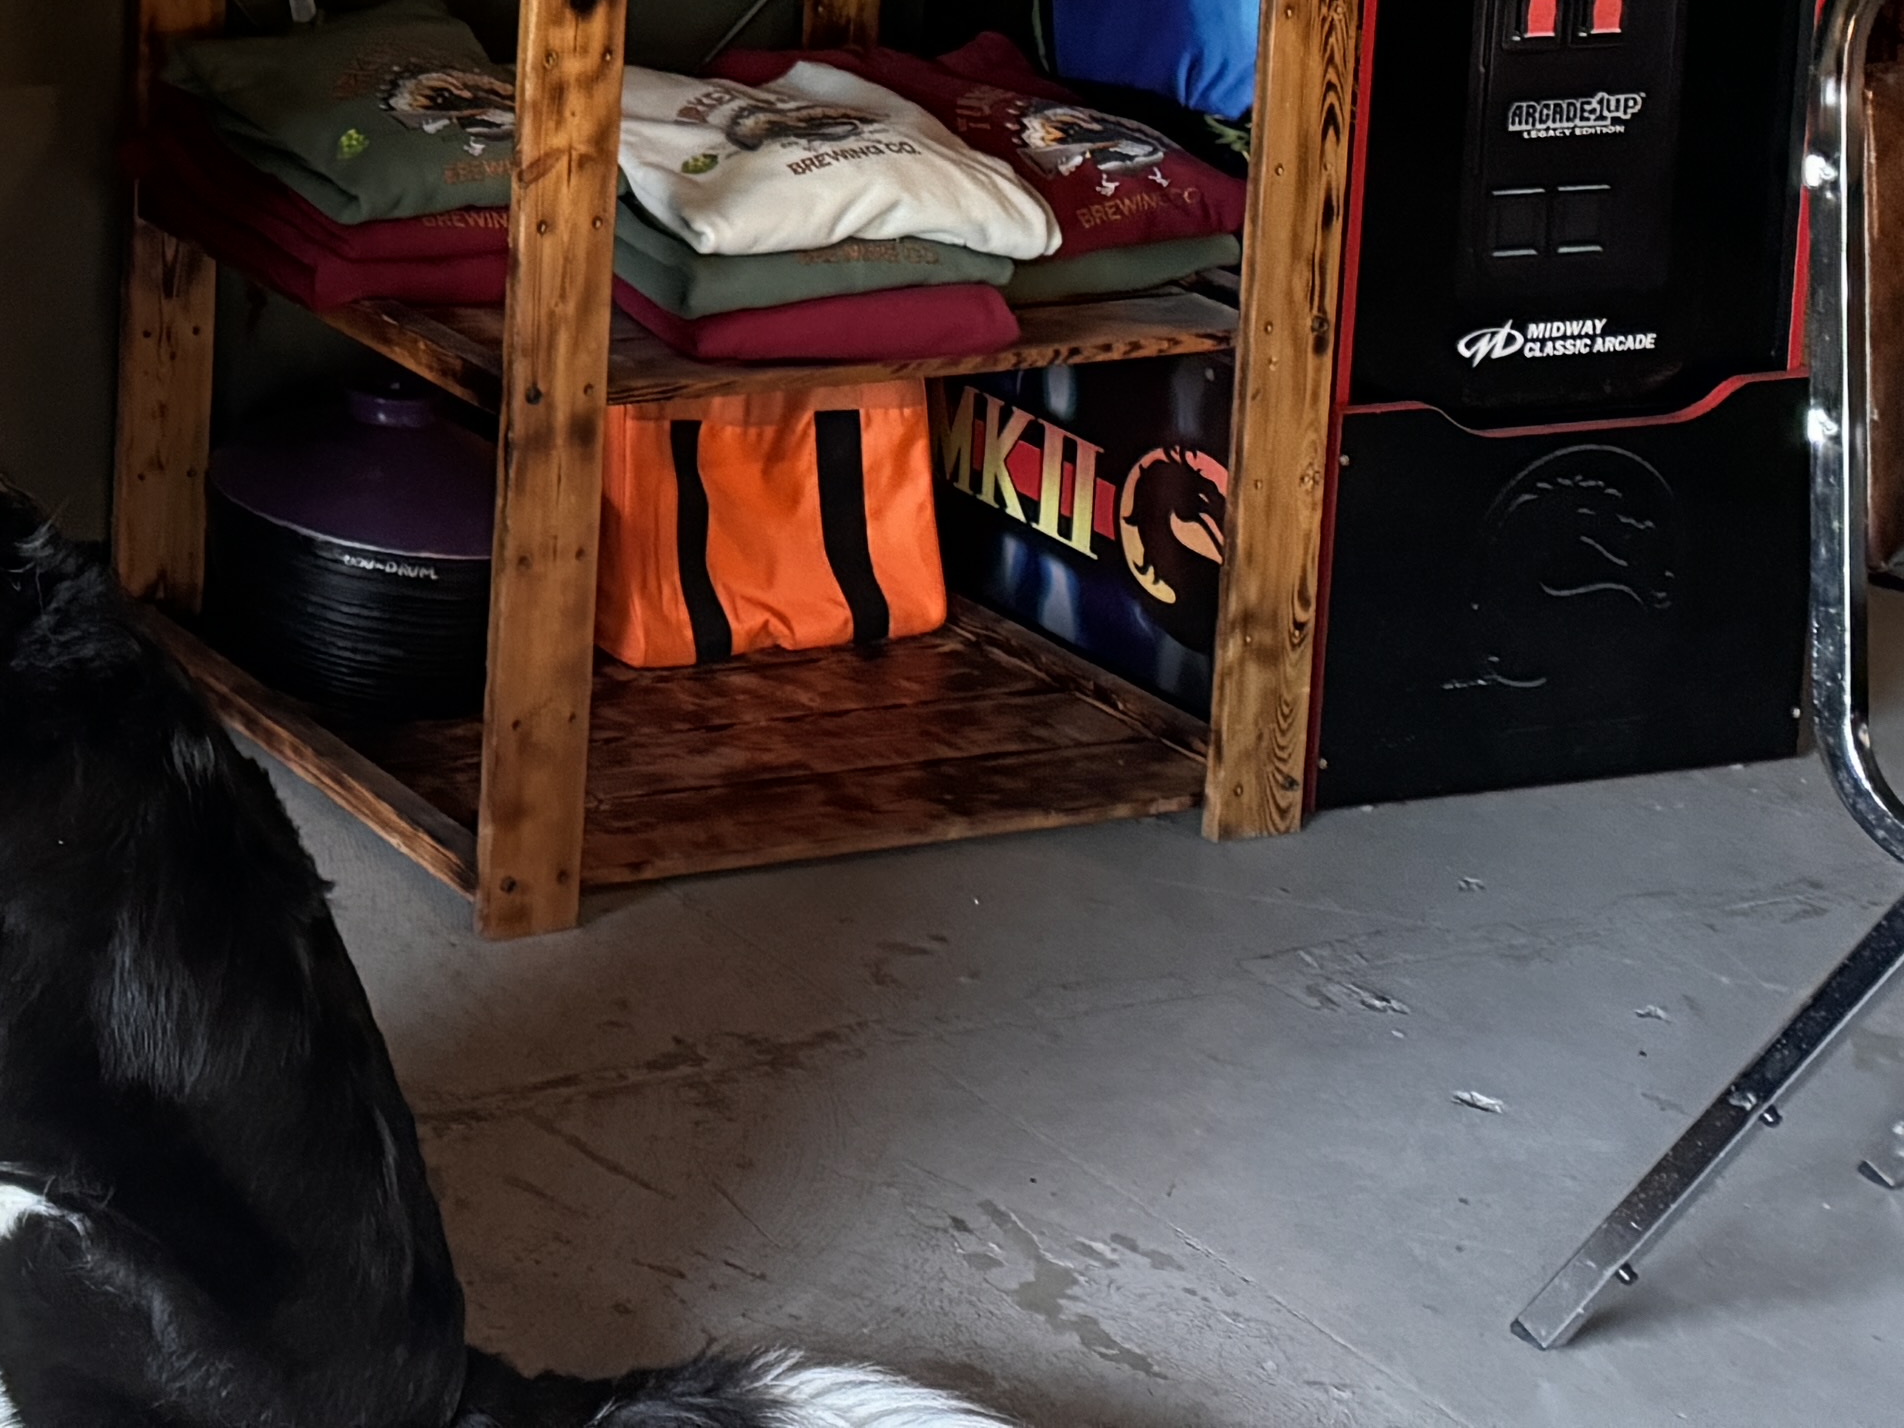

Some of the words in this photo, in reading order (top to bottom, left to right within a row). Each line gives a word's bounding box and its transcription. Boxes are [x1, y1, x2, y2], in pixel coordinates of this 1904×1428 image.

[1523, 129, 1572, 139] LEGACY
[1574, 125, 1626, 136] EDITION
[786, 144, 882, 176] BREWING
[1527, 318, 1608, 339] MIDWAY
[1524, 337, 1591, 358] CLASSIC
[1593, 333, 1658, 354] ARCADE
